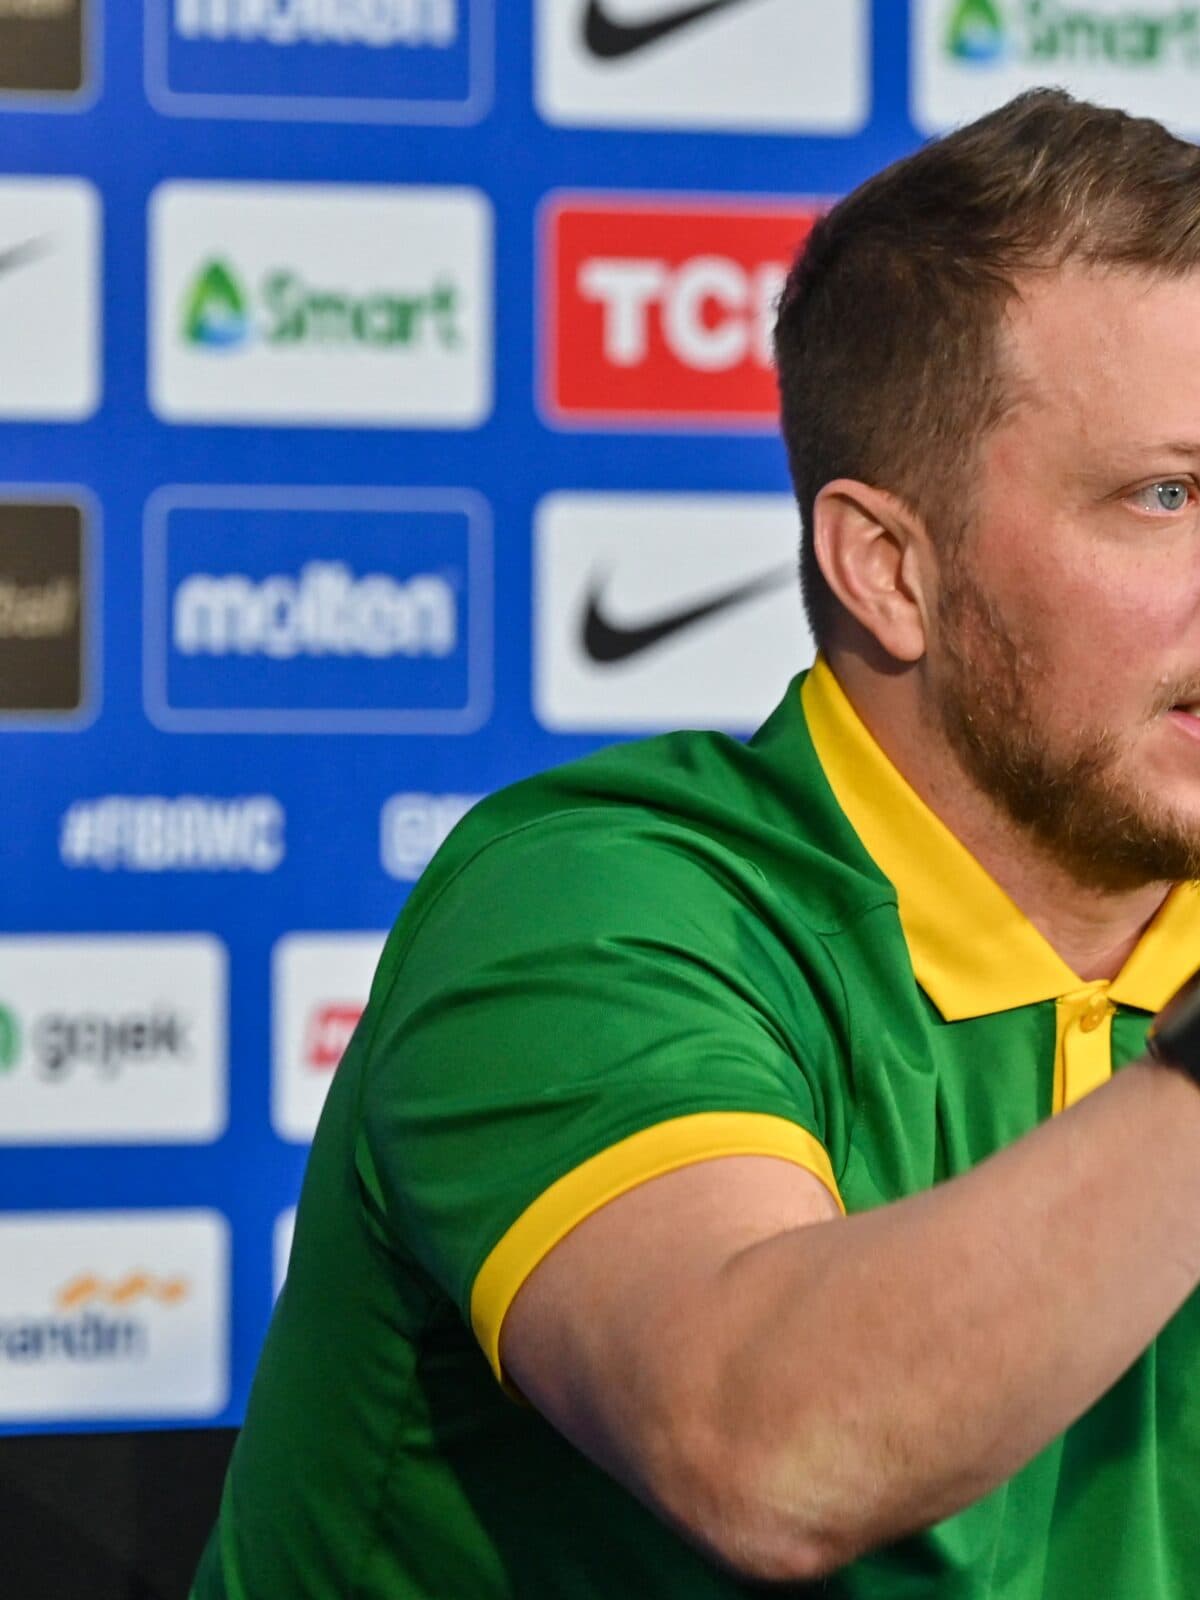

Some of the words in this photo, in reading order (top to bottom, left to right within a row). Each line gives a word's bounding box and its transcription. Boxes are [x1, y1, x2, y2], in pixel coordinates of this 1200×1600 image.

[264, 268, 459, 350] Smart
[579, 257, 774, 370] TC
[174, 562, 456, 657] molten
